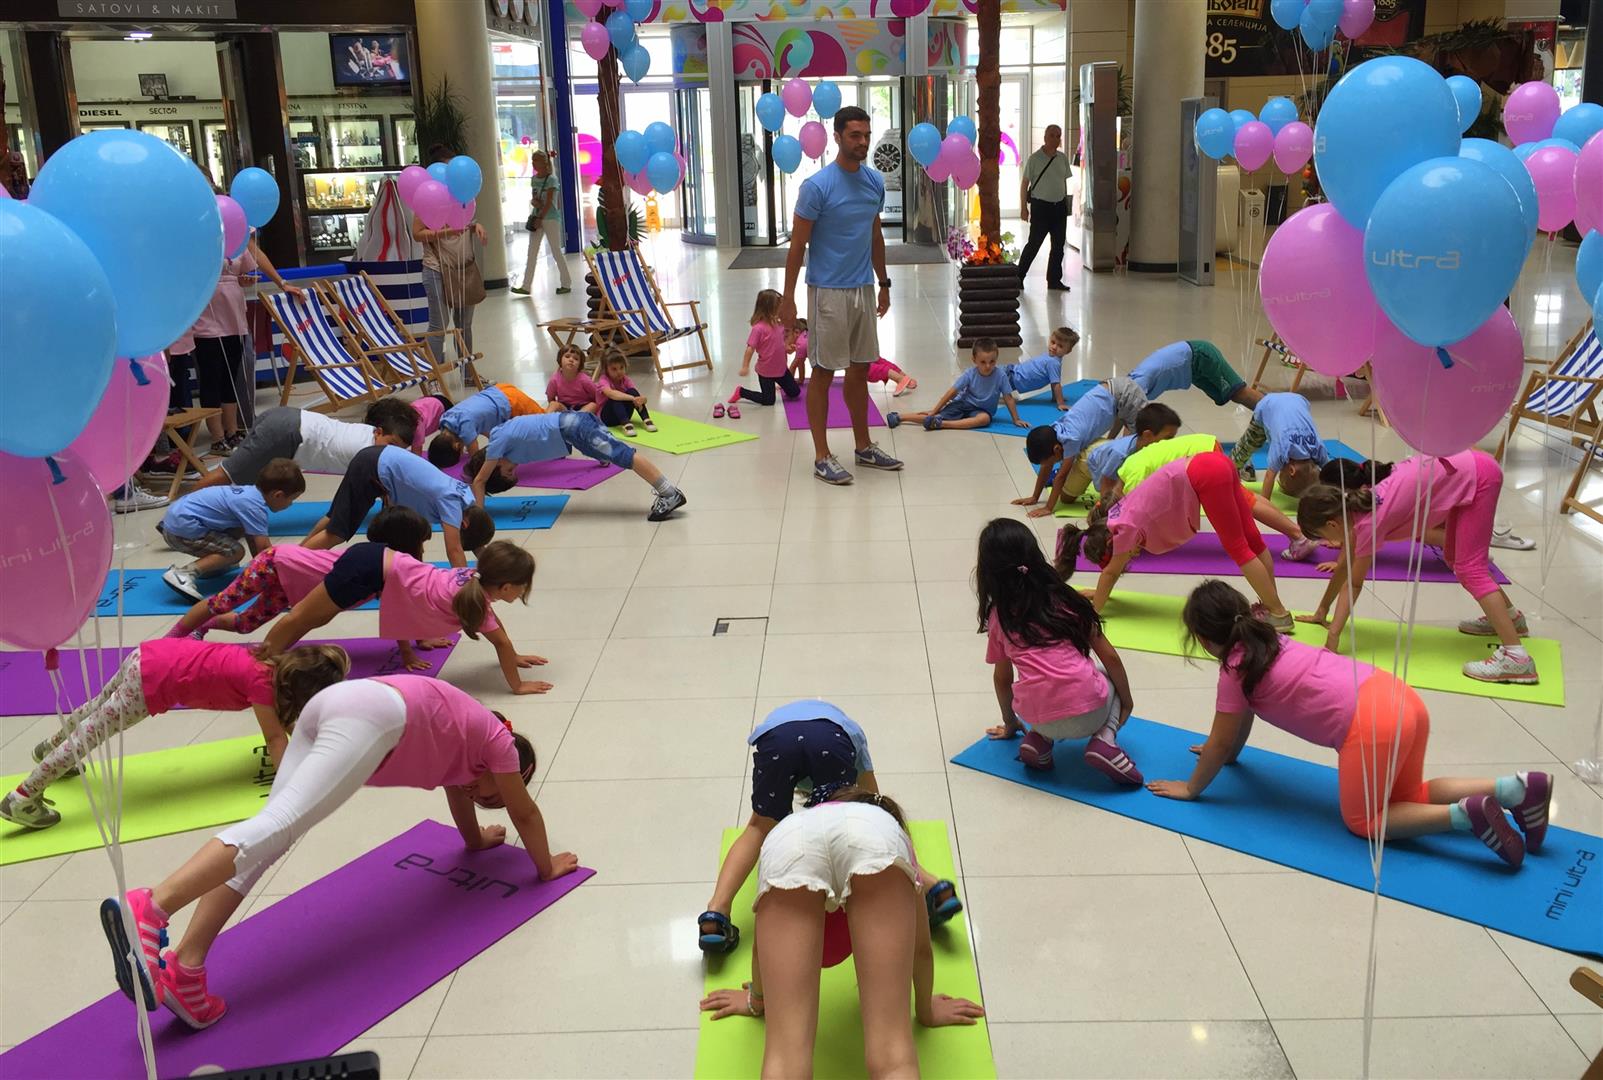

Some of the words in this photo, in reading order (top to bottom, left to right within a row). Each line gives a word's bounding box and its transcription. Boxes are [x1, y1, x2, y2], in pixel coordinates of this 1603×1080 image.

[76, 3, 140, 14] SATOVI
[151, 5, 161, 14] &
[171, 5, 219, 15] NAKIT
[1216, 18, 1267, 32] СЕЛЕКЦИЈА
[79, 109, 122, 117] DIESEL
[149, 107, 177, 115] SECTOR
[1372, 248, 1462, 270] ultra
[0, 547, 33, 568] ini
[392, 852, 520, 899] ultra
[1545, 887, 1575, 921] mini
[1563, 848, 1597, 888] ultra
